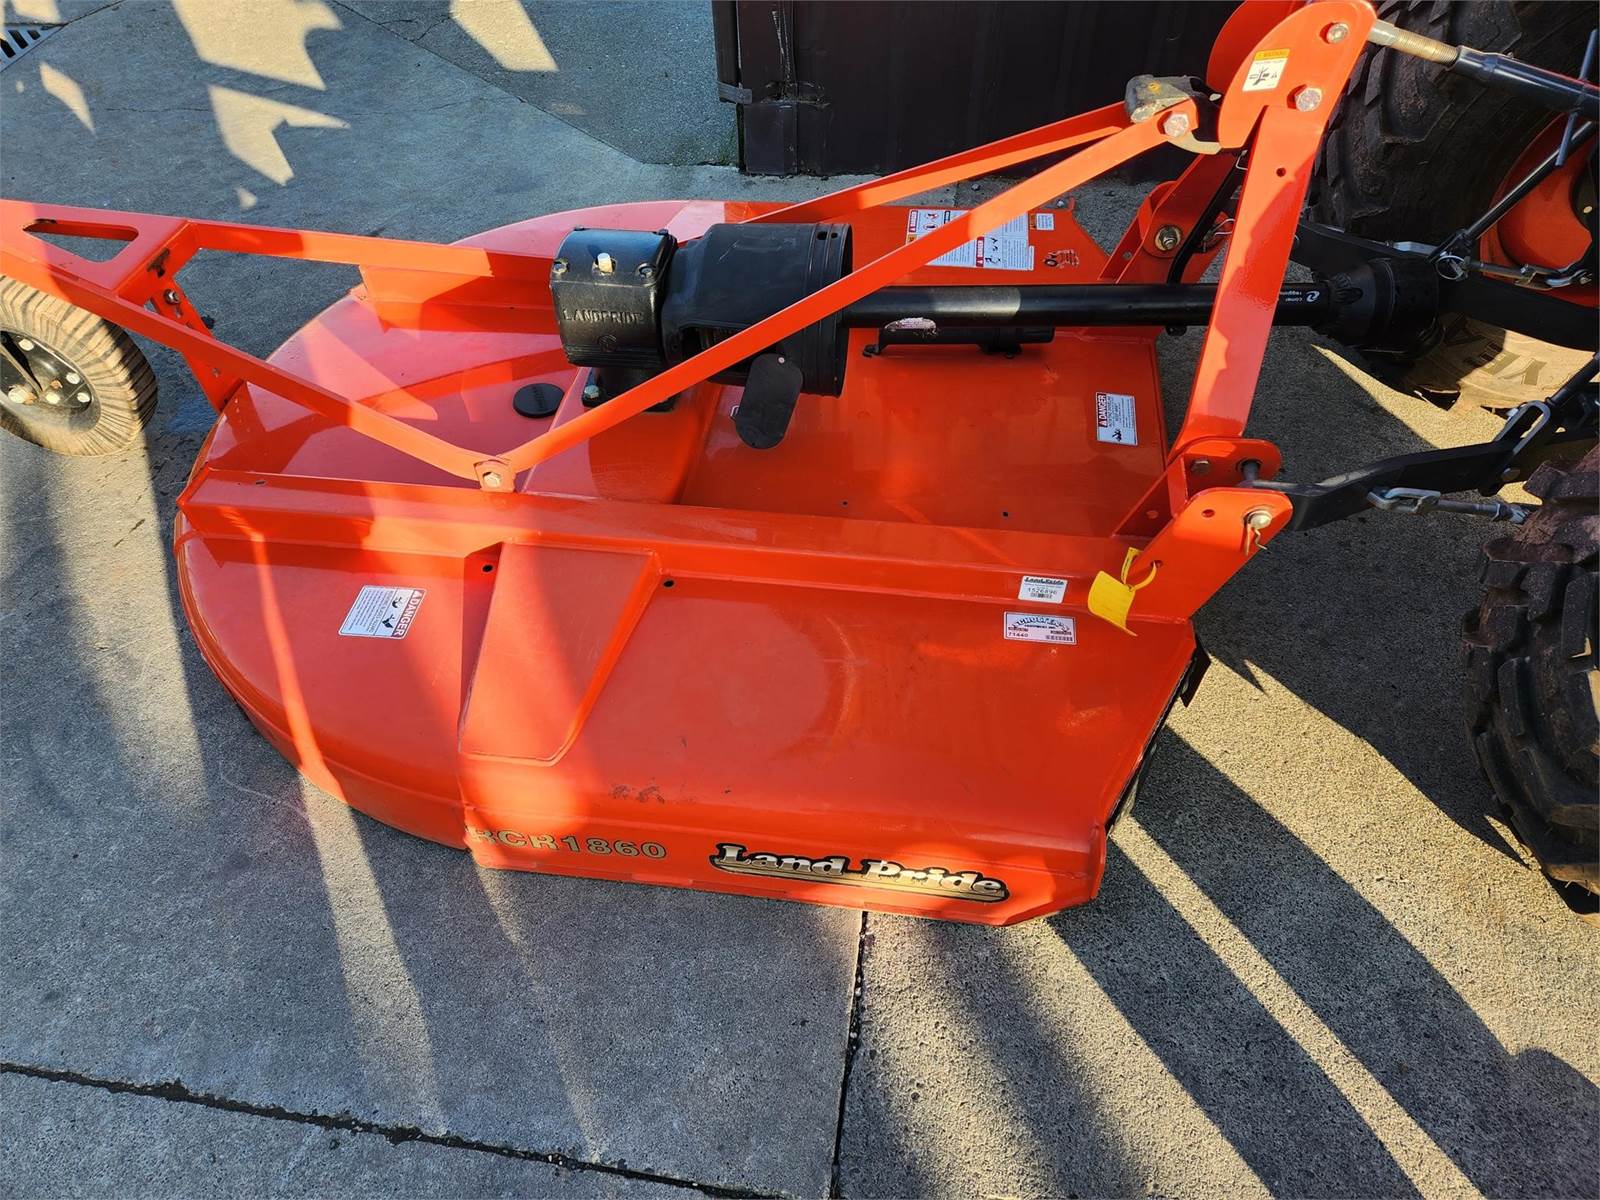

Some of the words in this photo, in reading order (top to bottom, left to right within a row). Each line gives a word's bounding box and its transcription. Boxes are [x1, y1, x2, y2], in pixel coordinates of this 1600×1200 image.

[1098, 394, 1106, 420] DANGER
[393, 597, 421, 636] DANGER
[465, 825, 667, 860] RCR1860
[716, 843, 846, 877] Land
[862, 858, 1005, 895] Pride
